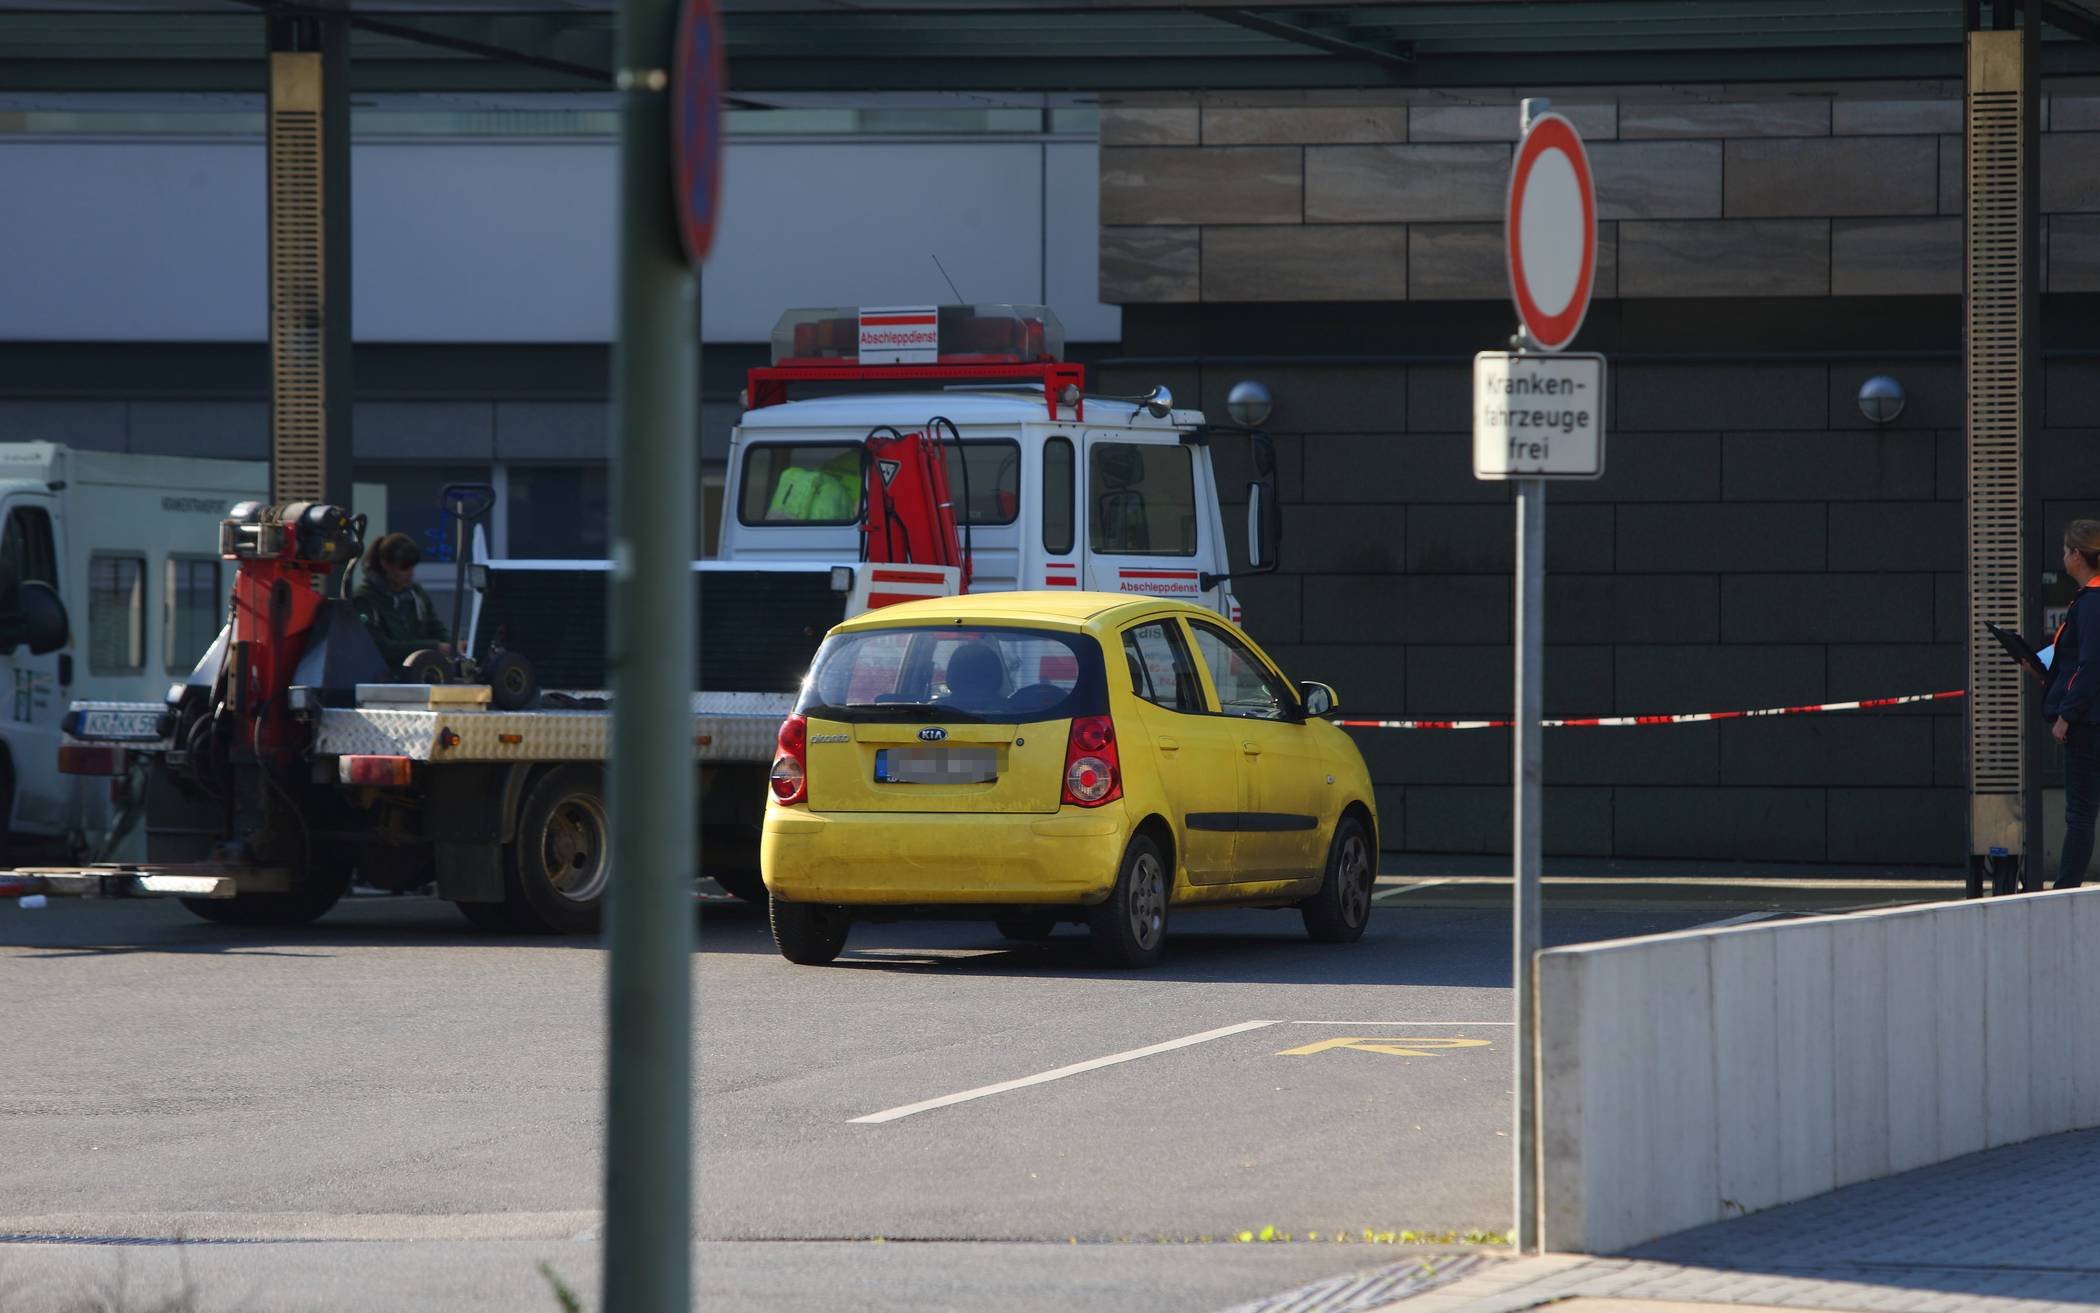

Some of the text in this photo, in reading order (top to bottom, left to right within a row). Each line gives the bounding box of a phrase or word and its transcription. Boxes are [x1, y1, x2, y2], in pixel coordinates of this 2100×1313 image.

[861, 330, 937, 346] Abschleppdienst
[1487, 372, 1585, 395] Kranken-
[1485, 405, 1590, 434] fahrzeuge
[1508, 437, 1550, 459] frei
[1120, 581, 1198, 593] Abschleppdienst
[921, 728, 943, 739] KIA
